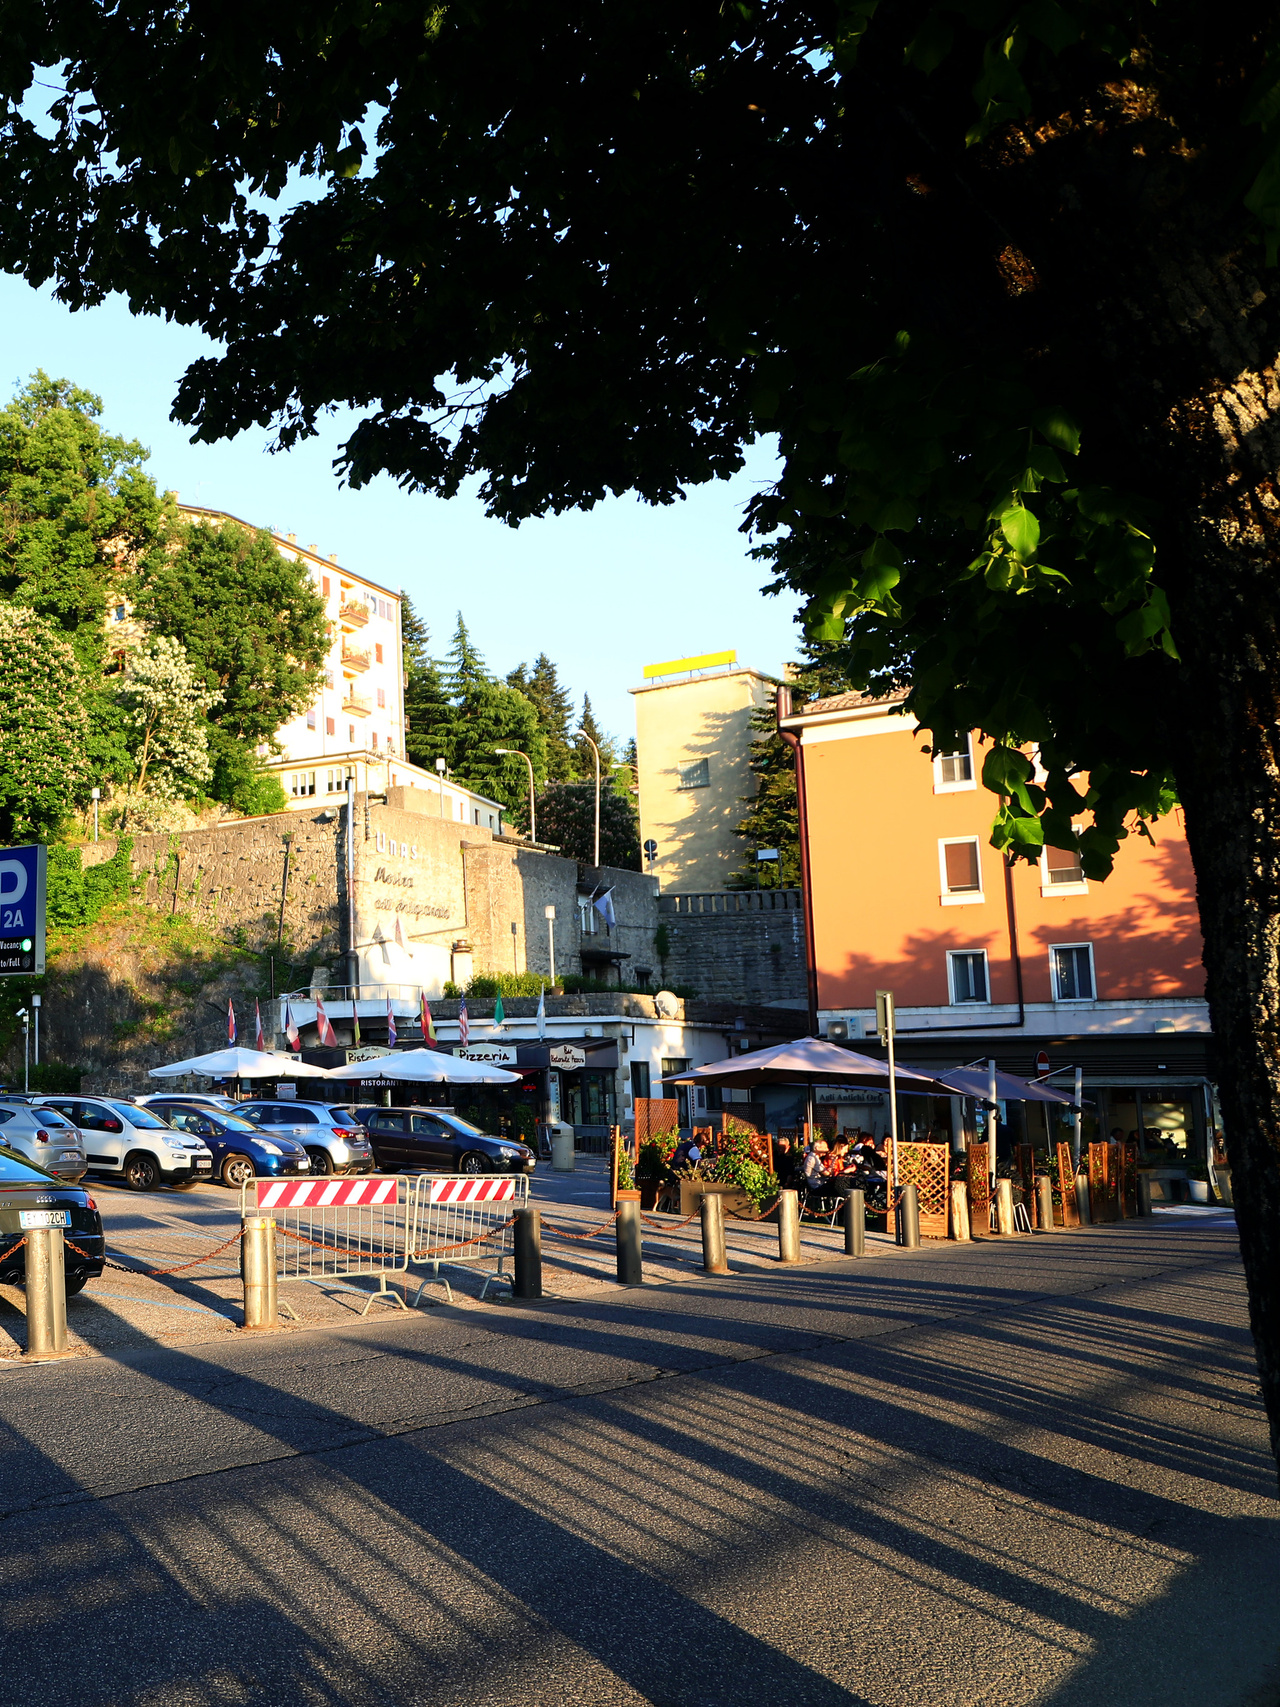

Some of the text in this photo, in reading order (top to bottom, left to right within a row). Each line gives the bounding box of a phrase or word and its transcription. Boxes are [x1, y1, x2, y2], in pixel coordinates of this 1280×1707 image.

[4, 909, 25, 928] 2A
[563, 1046, 573, 1055] Bar
[819, 1093, 835, 1102] Agli
[837, 1093, 865, 1101] Antichi
